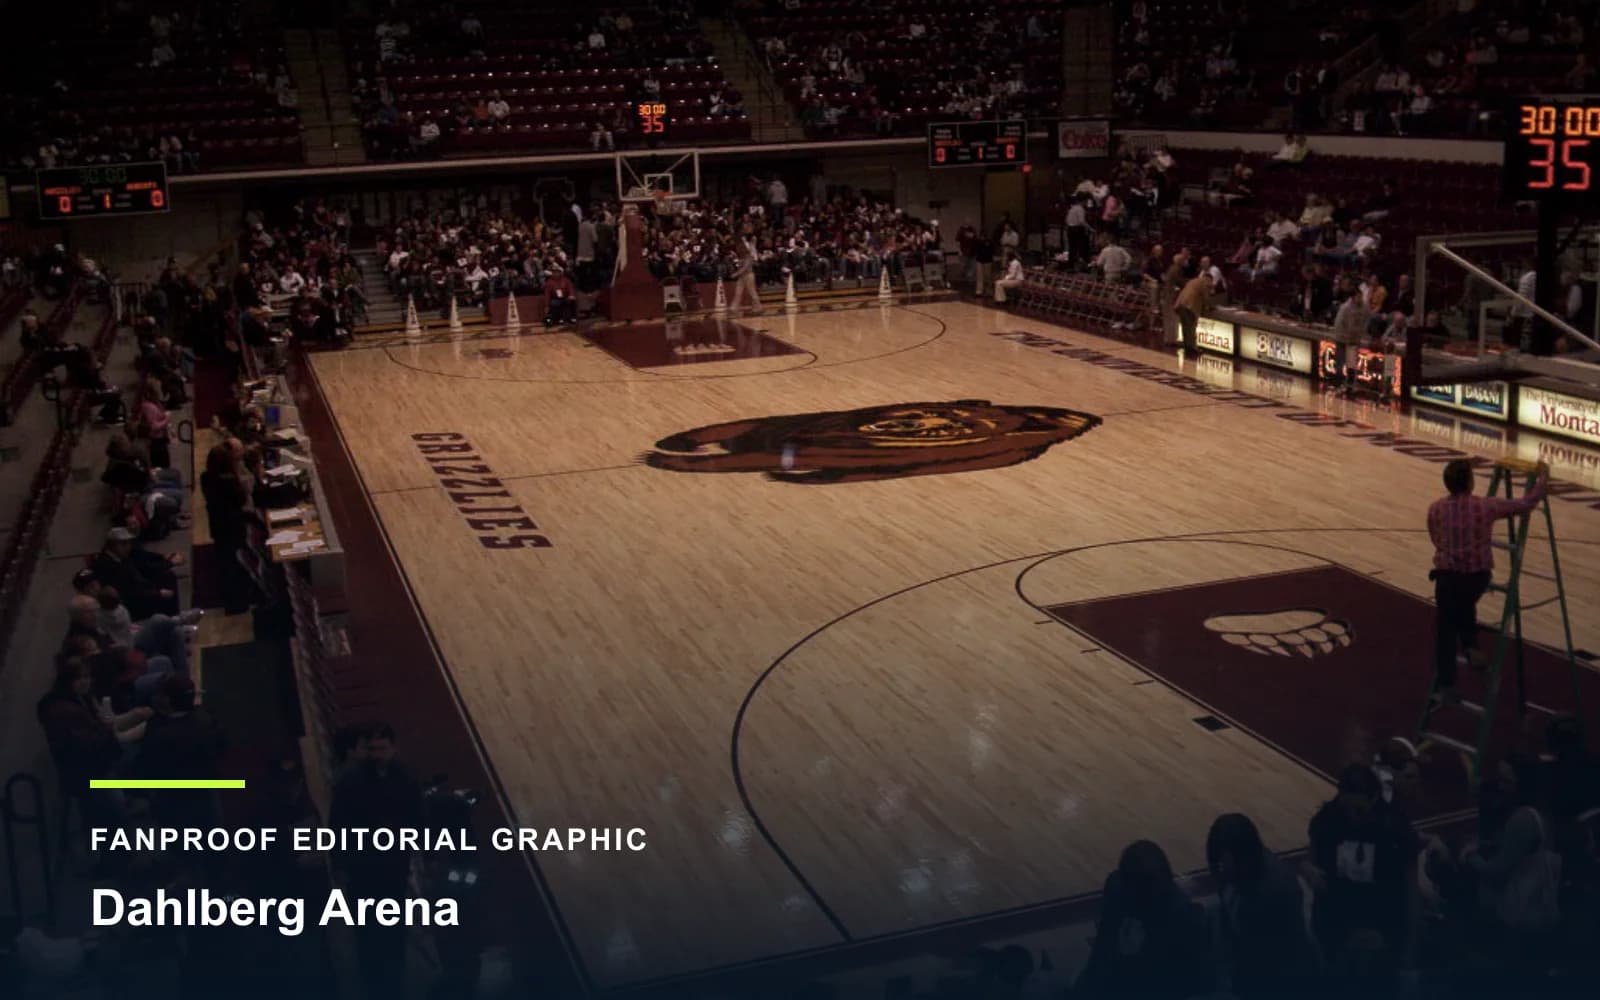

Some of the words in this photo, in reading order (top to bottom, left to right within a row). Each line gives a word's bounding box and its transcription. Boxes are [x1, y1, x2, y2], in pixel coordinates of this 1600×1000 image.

[640, 115, 665, 133] 35
[1520, 105, 1600, 135] 30:00
[1528, 138, 1591, 190] 35
[59, 195, 72, 213] 0
[151, 189, 164, 208] 0
[1198, 331, 1230, 350] ntana
[410, 432, 553, 549] GRIZZLIES
